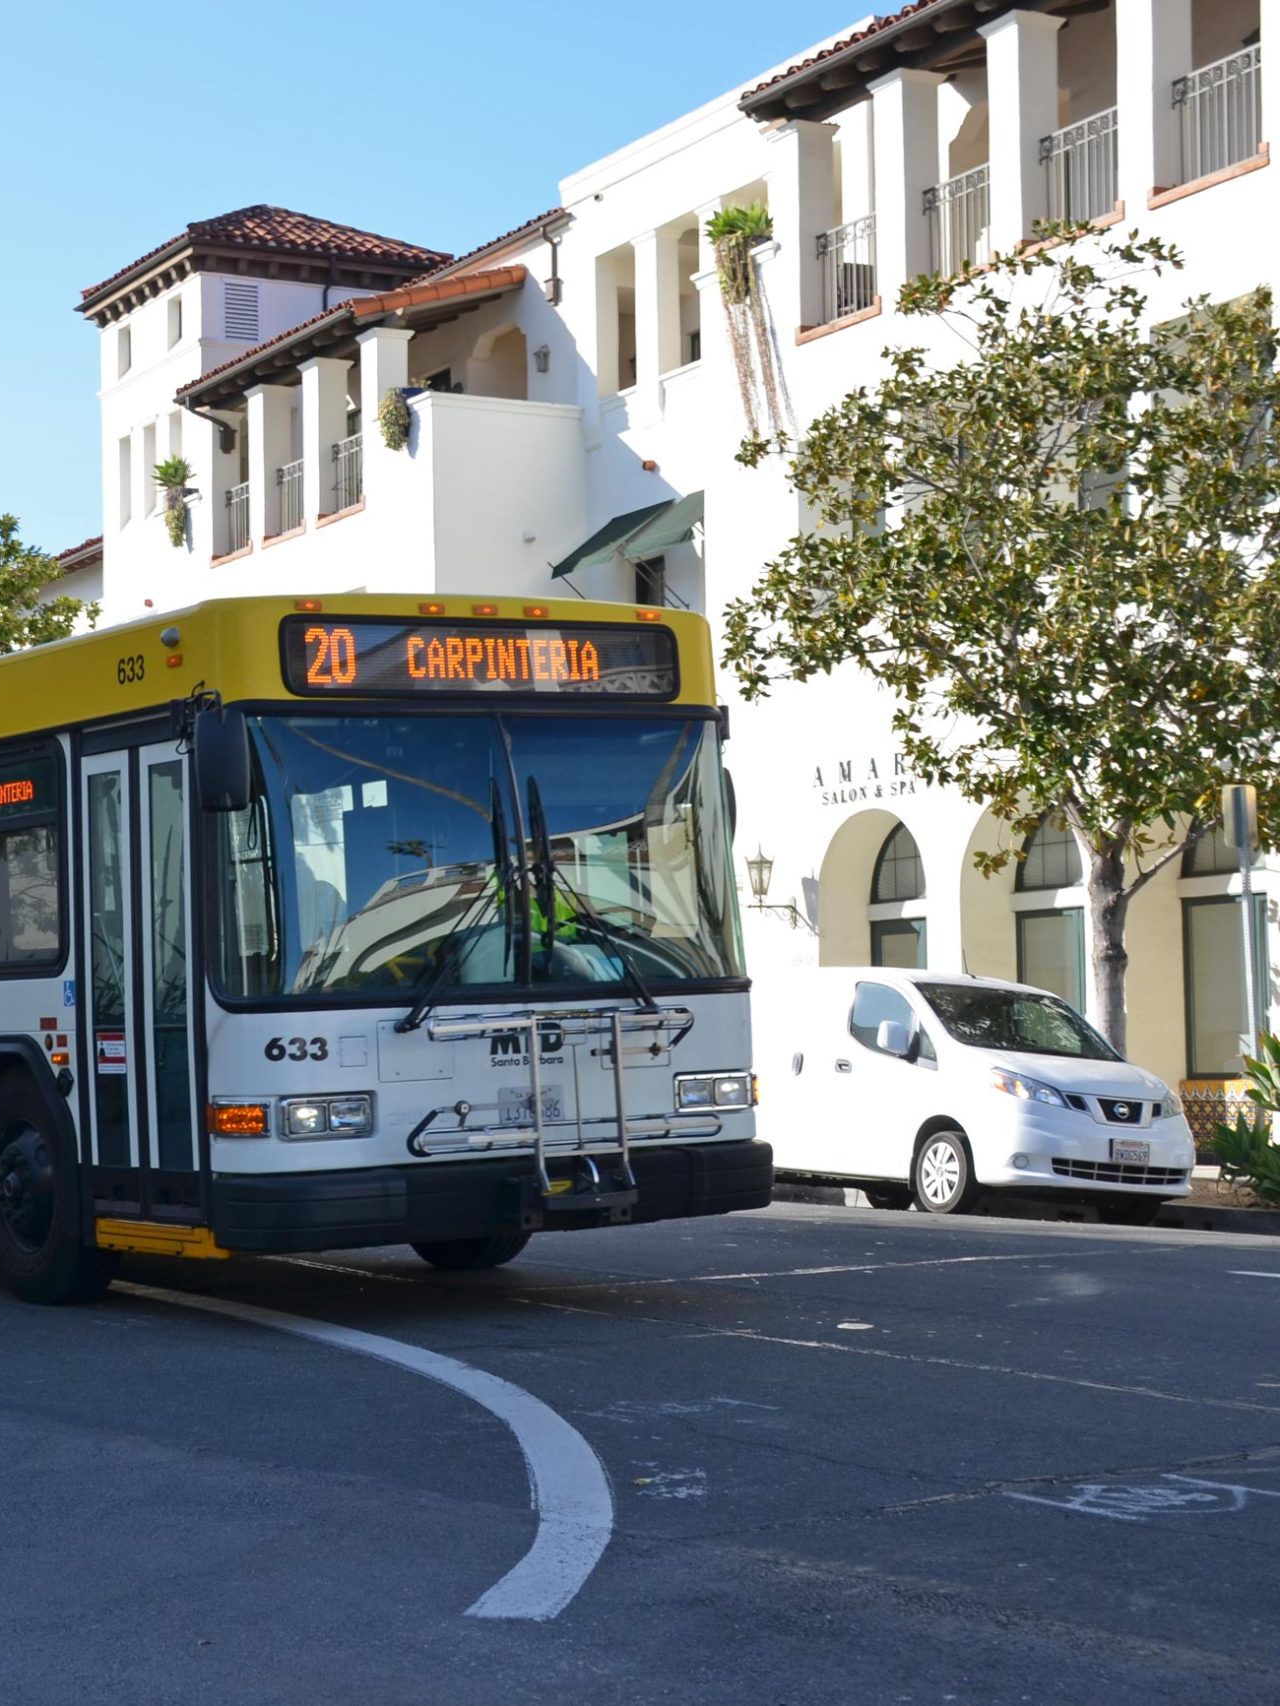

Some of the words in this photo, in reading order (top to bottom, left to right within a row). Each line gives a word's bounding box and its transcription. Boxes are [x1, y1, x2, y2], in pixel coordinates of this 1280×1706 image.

[304, 627, 357, 684] 20
[406, 636, 600, 682] CARPINTERIA
[117, 654, 144, 685] 633
[821, 785, 868, 806] SALON
[874, 785, 883, 798] &
[890, 780, 916, 796] SPA
[264, 1036, 329, 1062] 633
[491, 1057, 520, 1067] Santa
